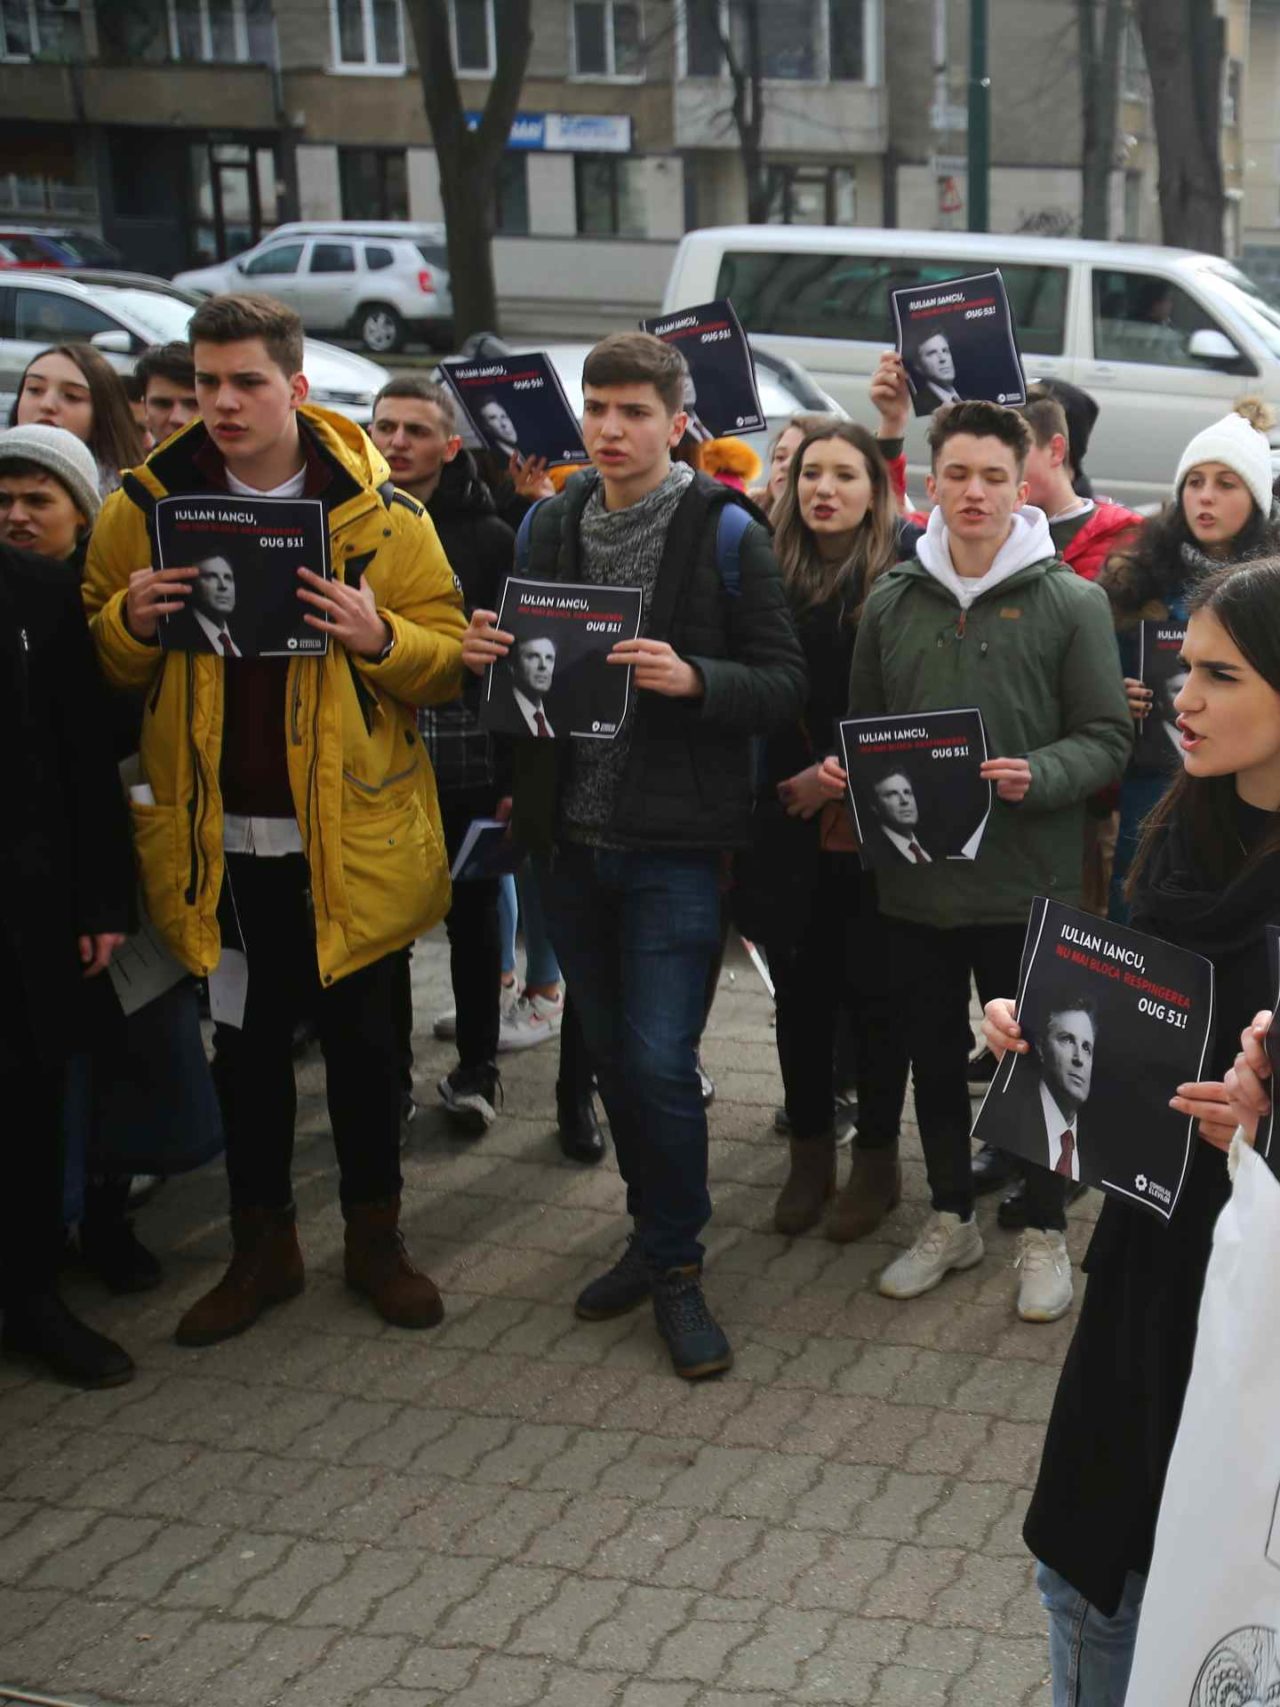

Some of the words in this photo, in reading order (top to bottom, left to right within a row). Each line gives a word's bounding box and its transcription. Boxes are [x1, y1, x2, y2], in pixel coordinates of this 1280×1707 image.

[909, 298, 937, 311] IULIAN
[175, 510, 215, 521] IULIAN
[218, 511, 257, 526] IANCU,
[259, 537, 284, 548] OUG
[286, 536, 304, 548] 51!
[520, 593, 555, 607] IULIAN
[556, 597, 590, 612] IANCU,
[586, 621, 605, 632] OUG
[606, 622, 622, 633] 51!
[859, 730, 892, 744] IULIAN
[894, 728, 929, 740] IANCU,
[931, 748, 952, 759] OUG
[954, 746, 969, 757] 51!
[1060, 924, 1102, 953] IULIAN
[1103, 941, 1146, 974] IANCU,
[1055, 944, 1071, 959] NU
[1071, 949, 1089, 967] MAI
[1088, 956, 1121, 980] BLOCA
[1123, 971, 1191, 1010] RESPINGEREA
[1138, 997, 1166, 1020] OUG
[1166, 1009, 1188, 1029] 51!
